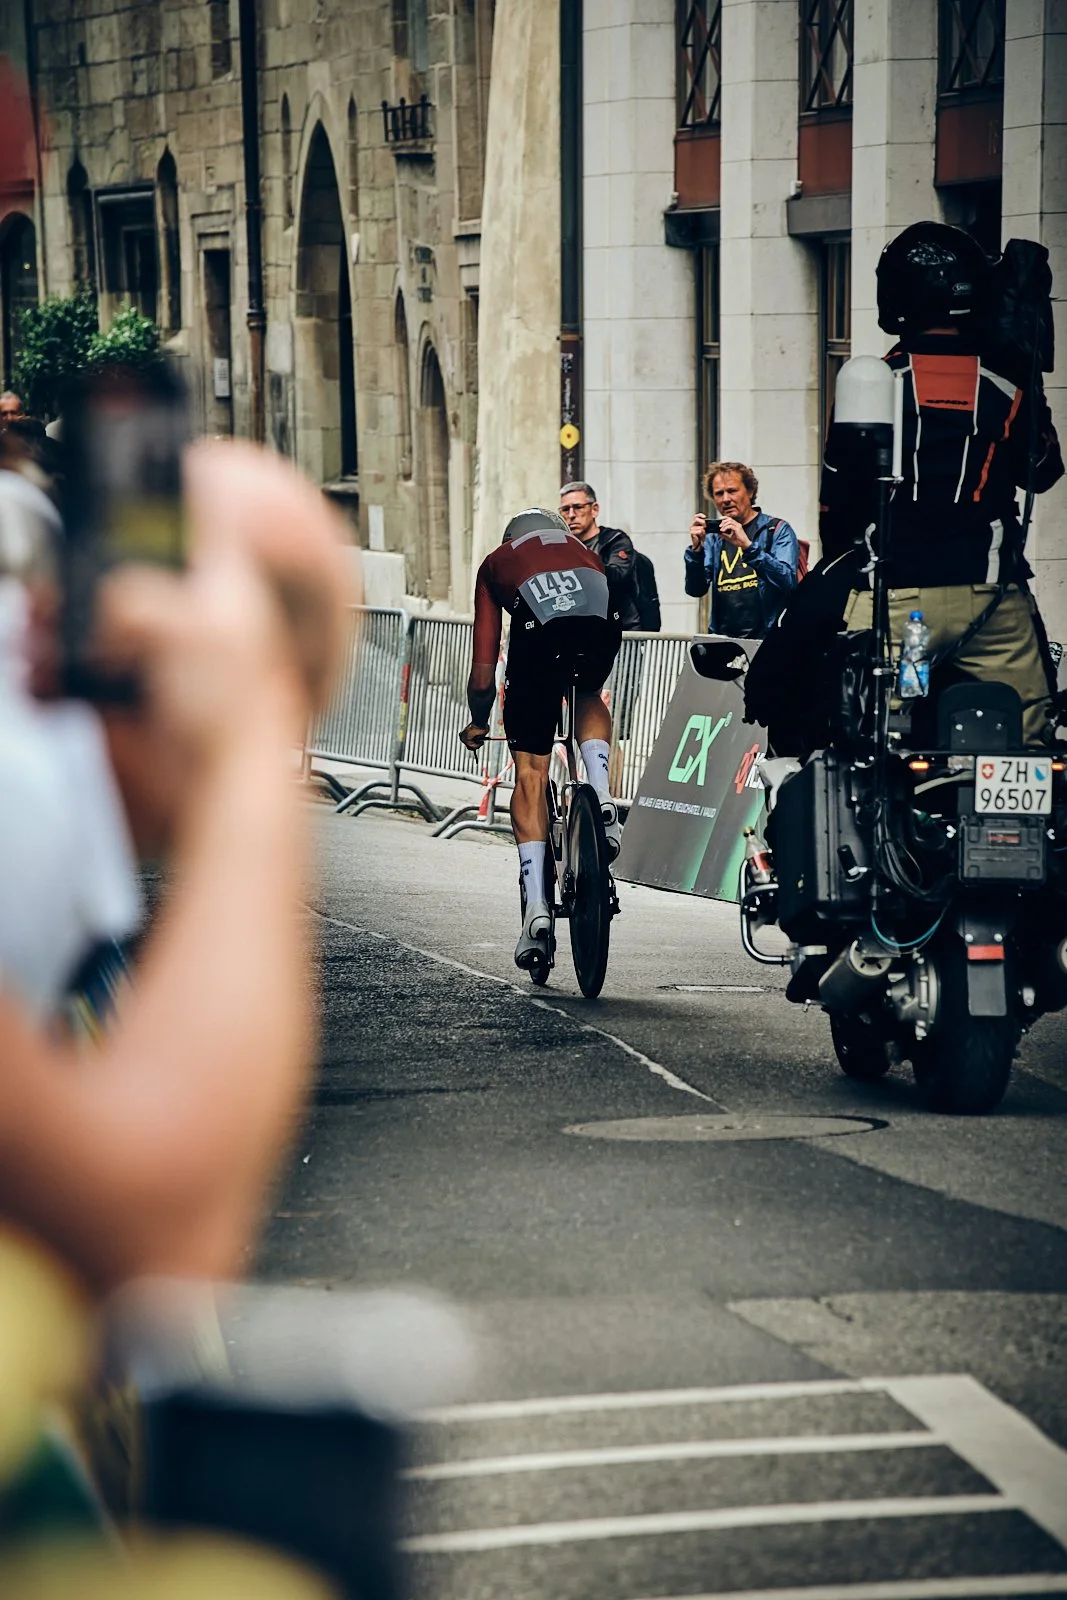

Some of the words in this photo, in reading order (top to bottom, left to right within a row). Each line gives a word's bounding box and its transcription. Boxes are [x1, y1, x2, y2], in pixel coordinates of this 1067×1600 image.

[530, 570, 577, 600] 145
[1000, 760, 1029, 783] ZH
[980, 788, 1047, 812] 96507
